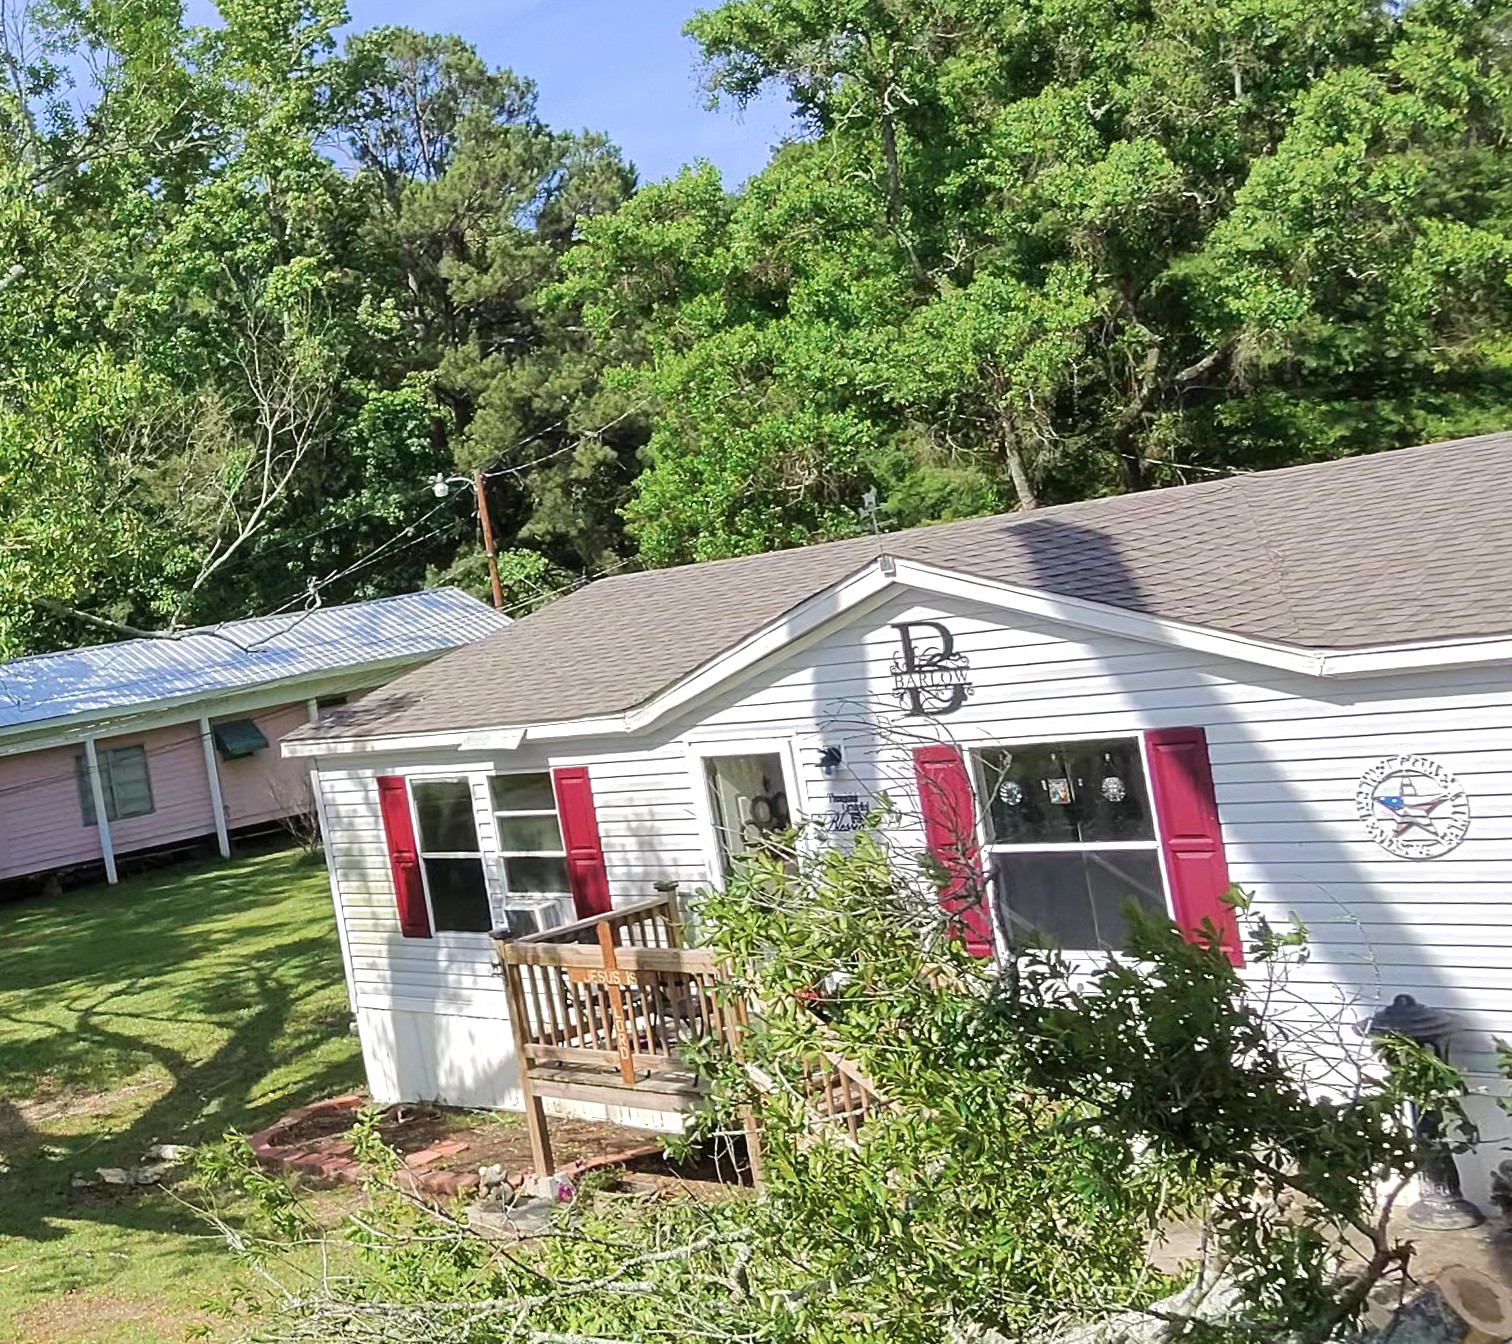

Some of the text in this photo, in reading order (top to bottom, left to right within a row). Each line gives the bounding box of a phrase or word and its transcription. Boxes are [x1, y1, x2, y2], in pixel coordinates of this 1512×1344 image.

[894, 668, 968, 689] BARLOW
[584, 969, 638, 985] JESUS IS
[613, 1005, 629, 1060] LORD
